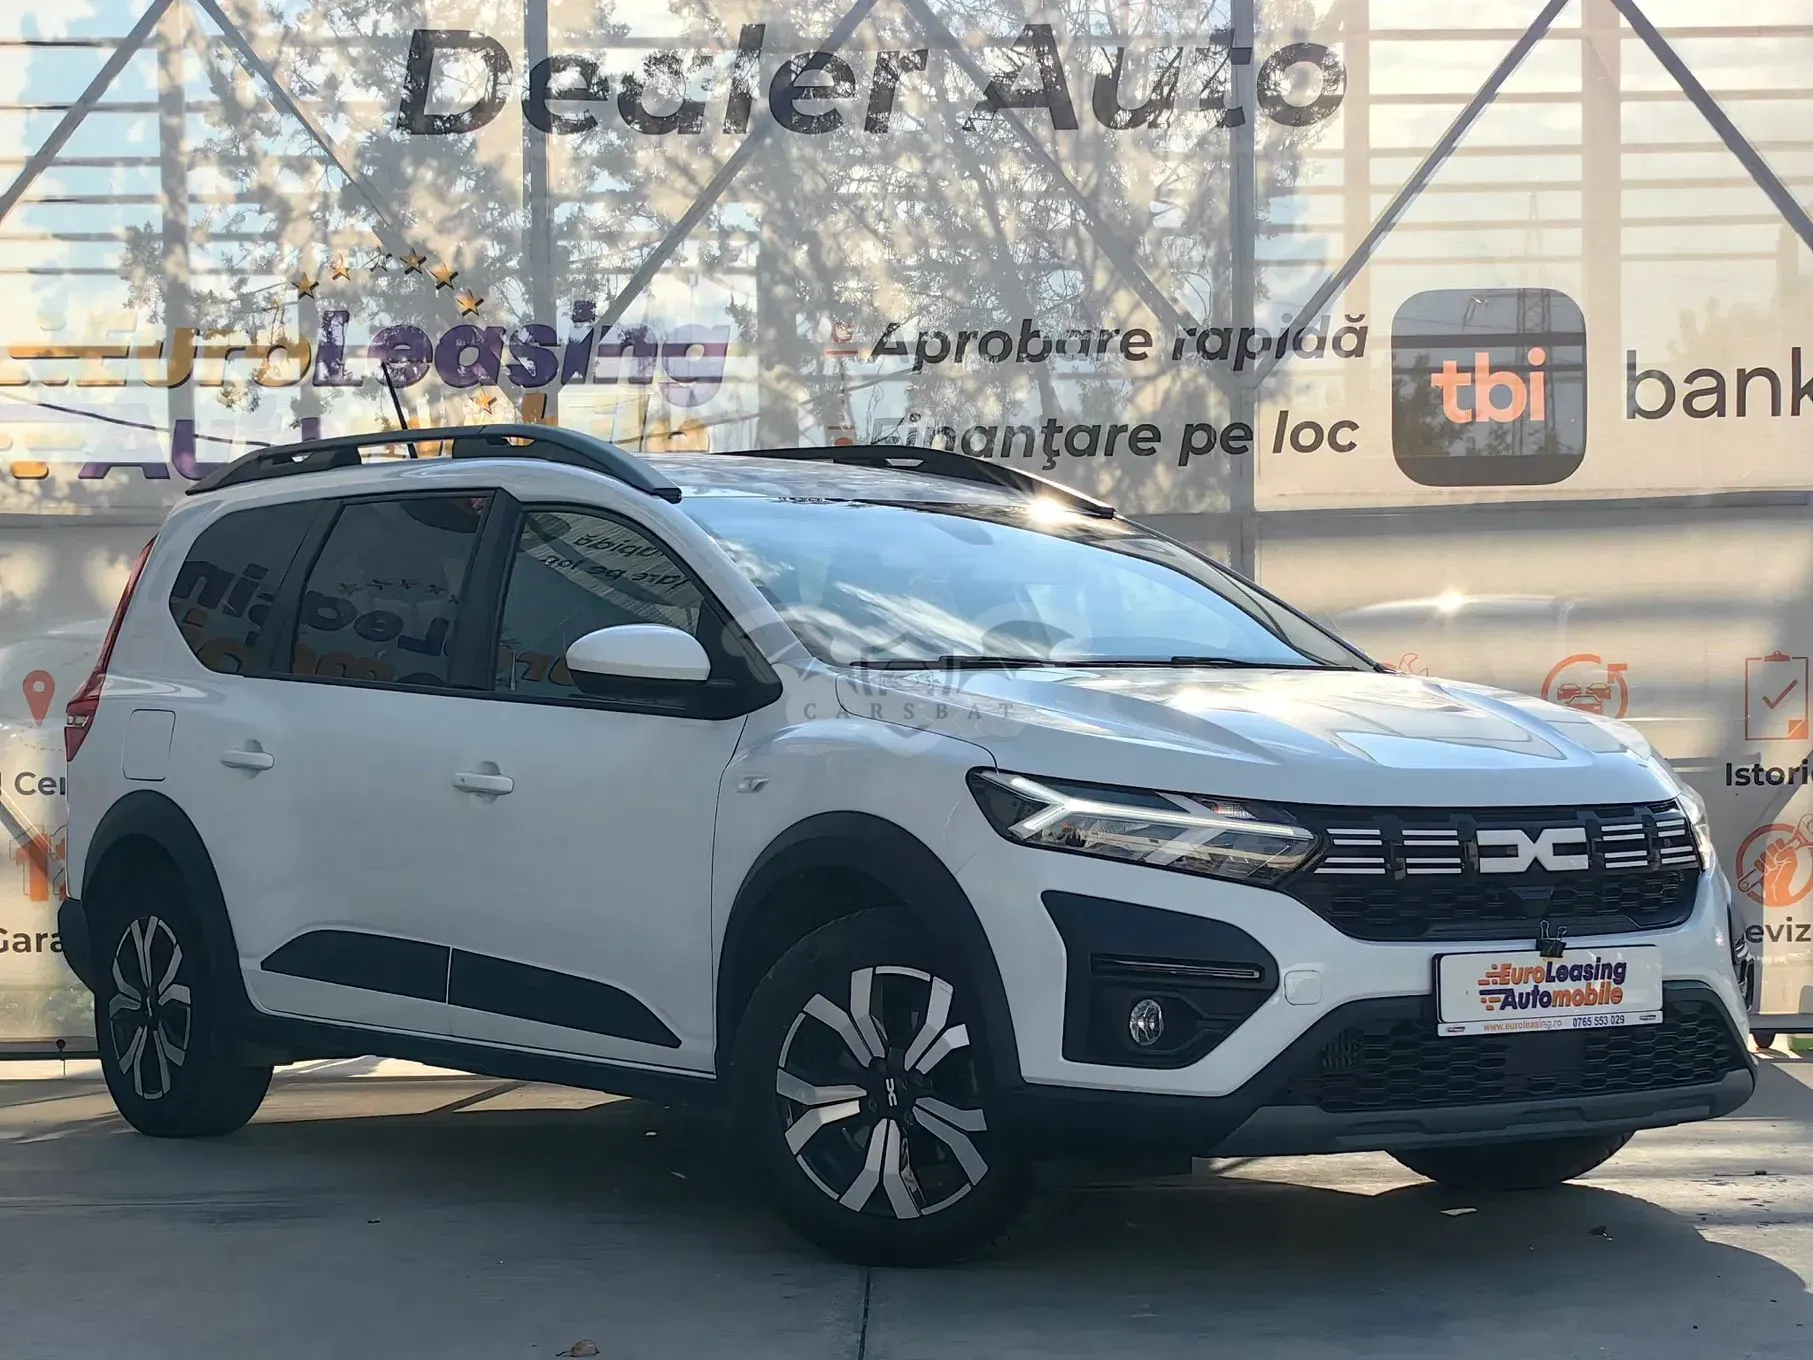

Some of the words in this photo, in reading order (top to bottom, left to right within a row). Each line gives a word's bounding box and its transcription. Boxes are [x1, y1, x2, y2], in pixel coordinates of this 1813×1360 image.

[396, 23, 927, 134] Dealer
[962, 23, 1347, 130] Auto
[870, 319, 1153, 371] Aprobare
[1172, 313, 1369, 371] rapidă
[1431, 347, 1546, 423] tbi
[1178, 422, 1253, 466] pe
[1272, 410, 1360, 453] loc
[1725, 759, 1813, 786] Istori
[1499, 957, 1627, 985] EuroLeasing
[1499, 982, 1623, 1010] Automobile
[1573, 1017, 1592, 1028] 0765
[1611, 1014, 1626, 1025] 029
